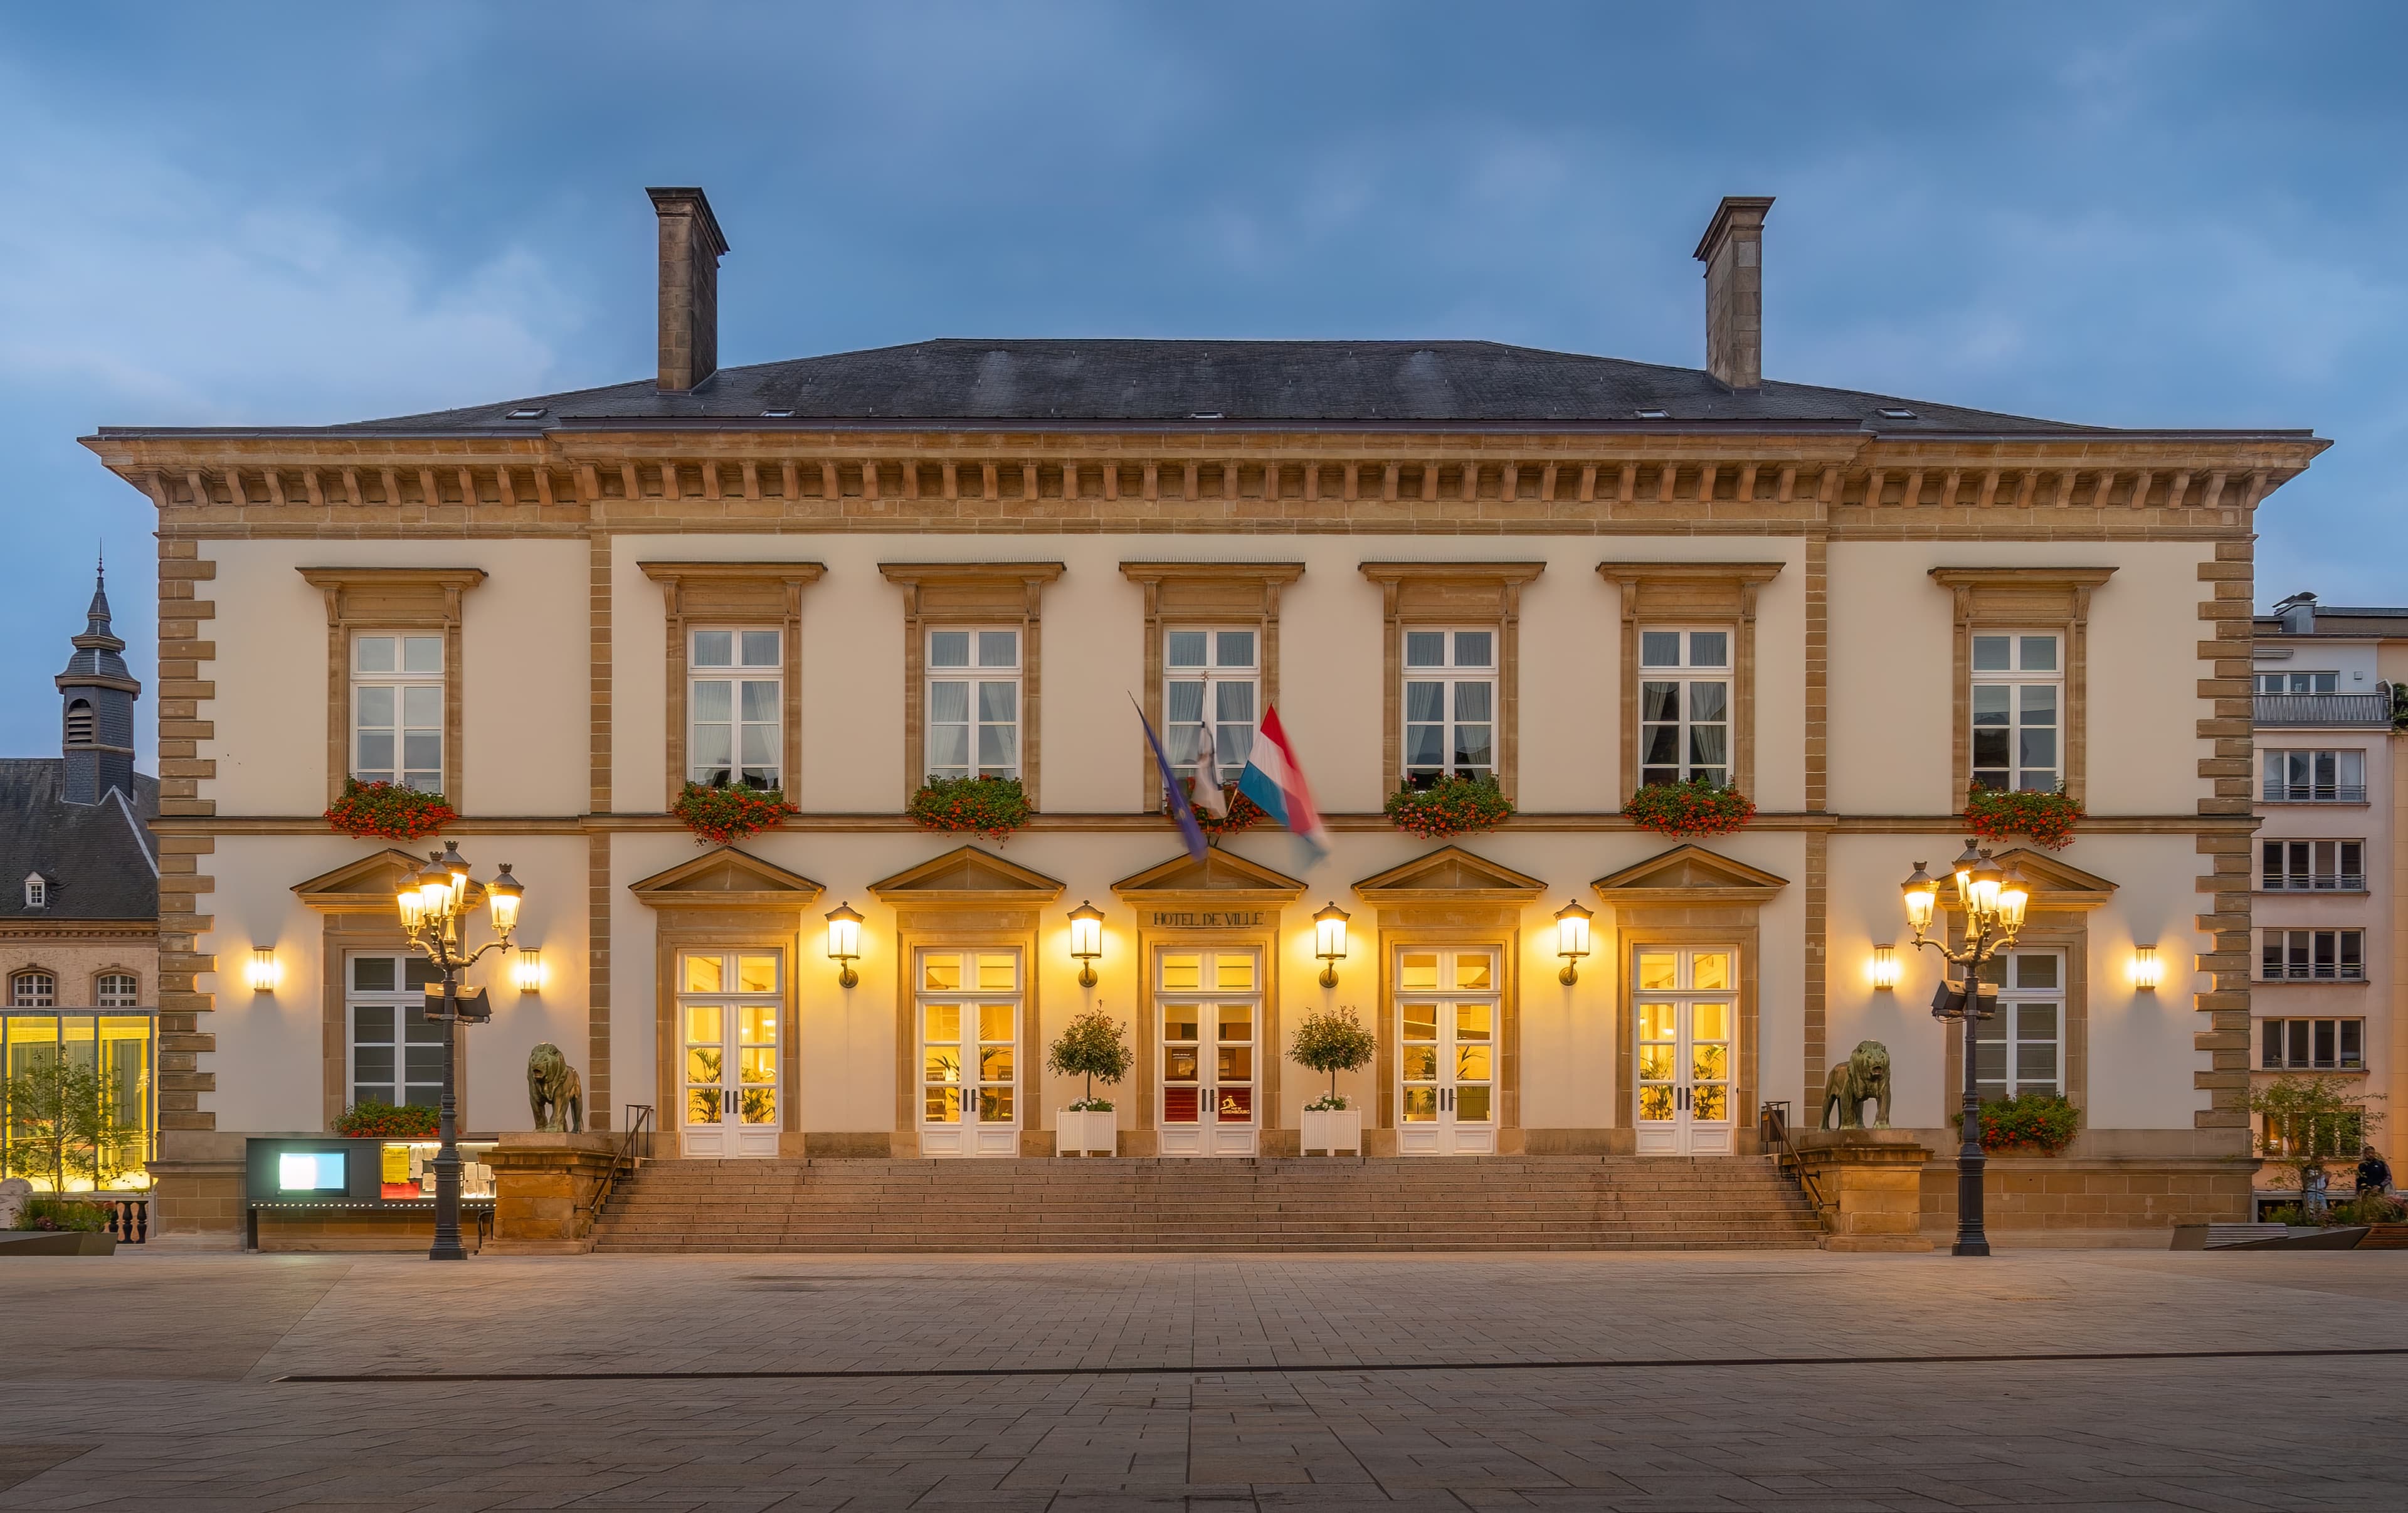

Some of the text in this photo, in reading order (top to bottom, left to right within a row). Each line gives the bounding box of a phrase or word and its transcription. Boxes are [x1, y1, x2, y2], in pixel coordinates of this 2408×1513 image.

[1154, 913, 1264, 926] HOTEL DE VILLE
